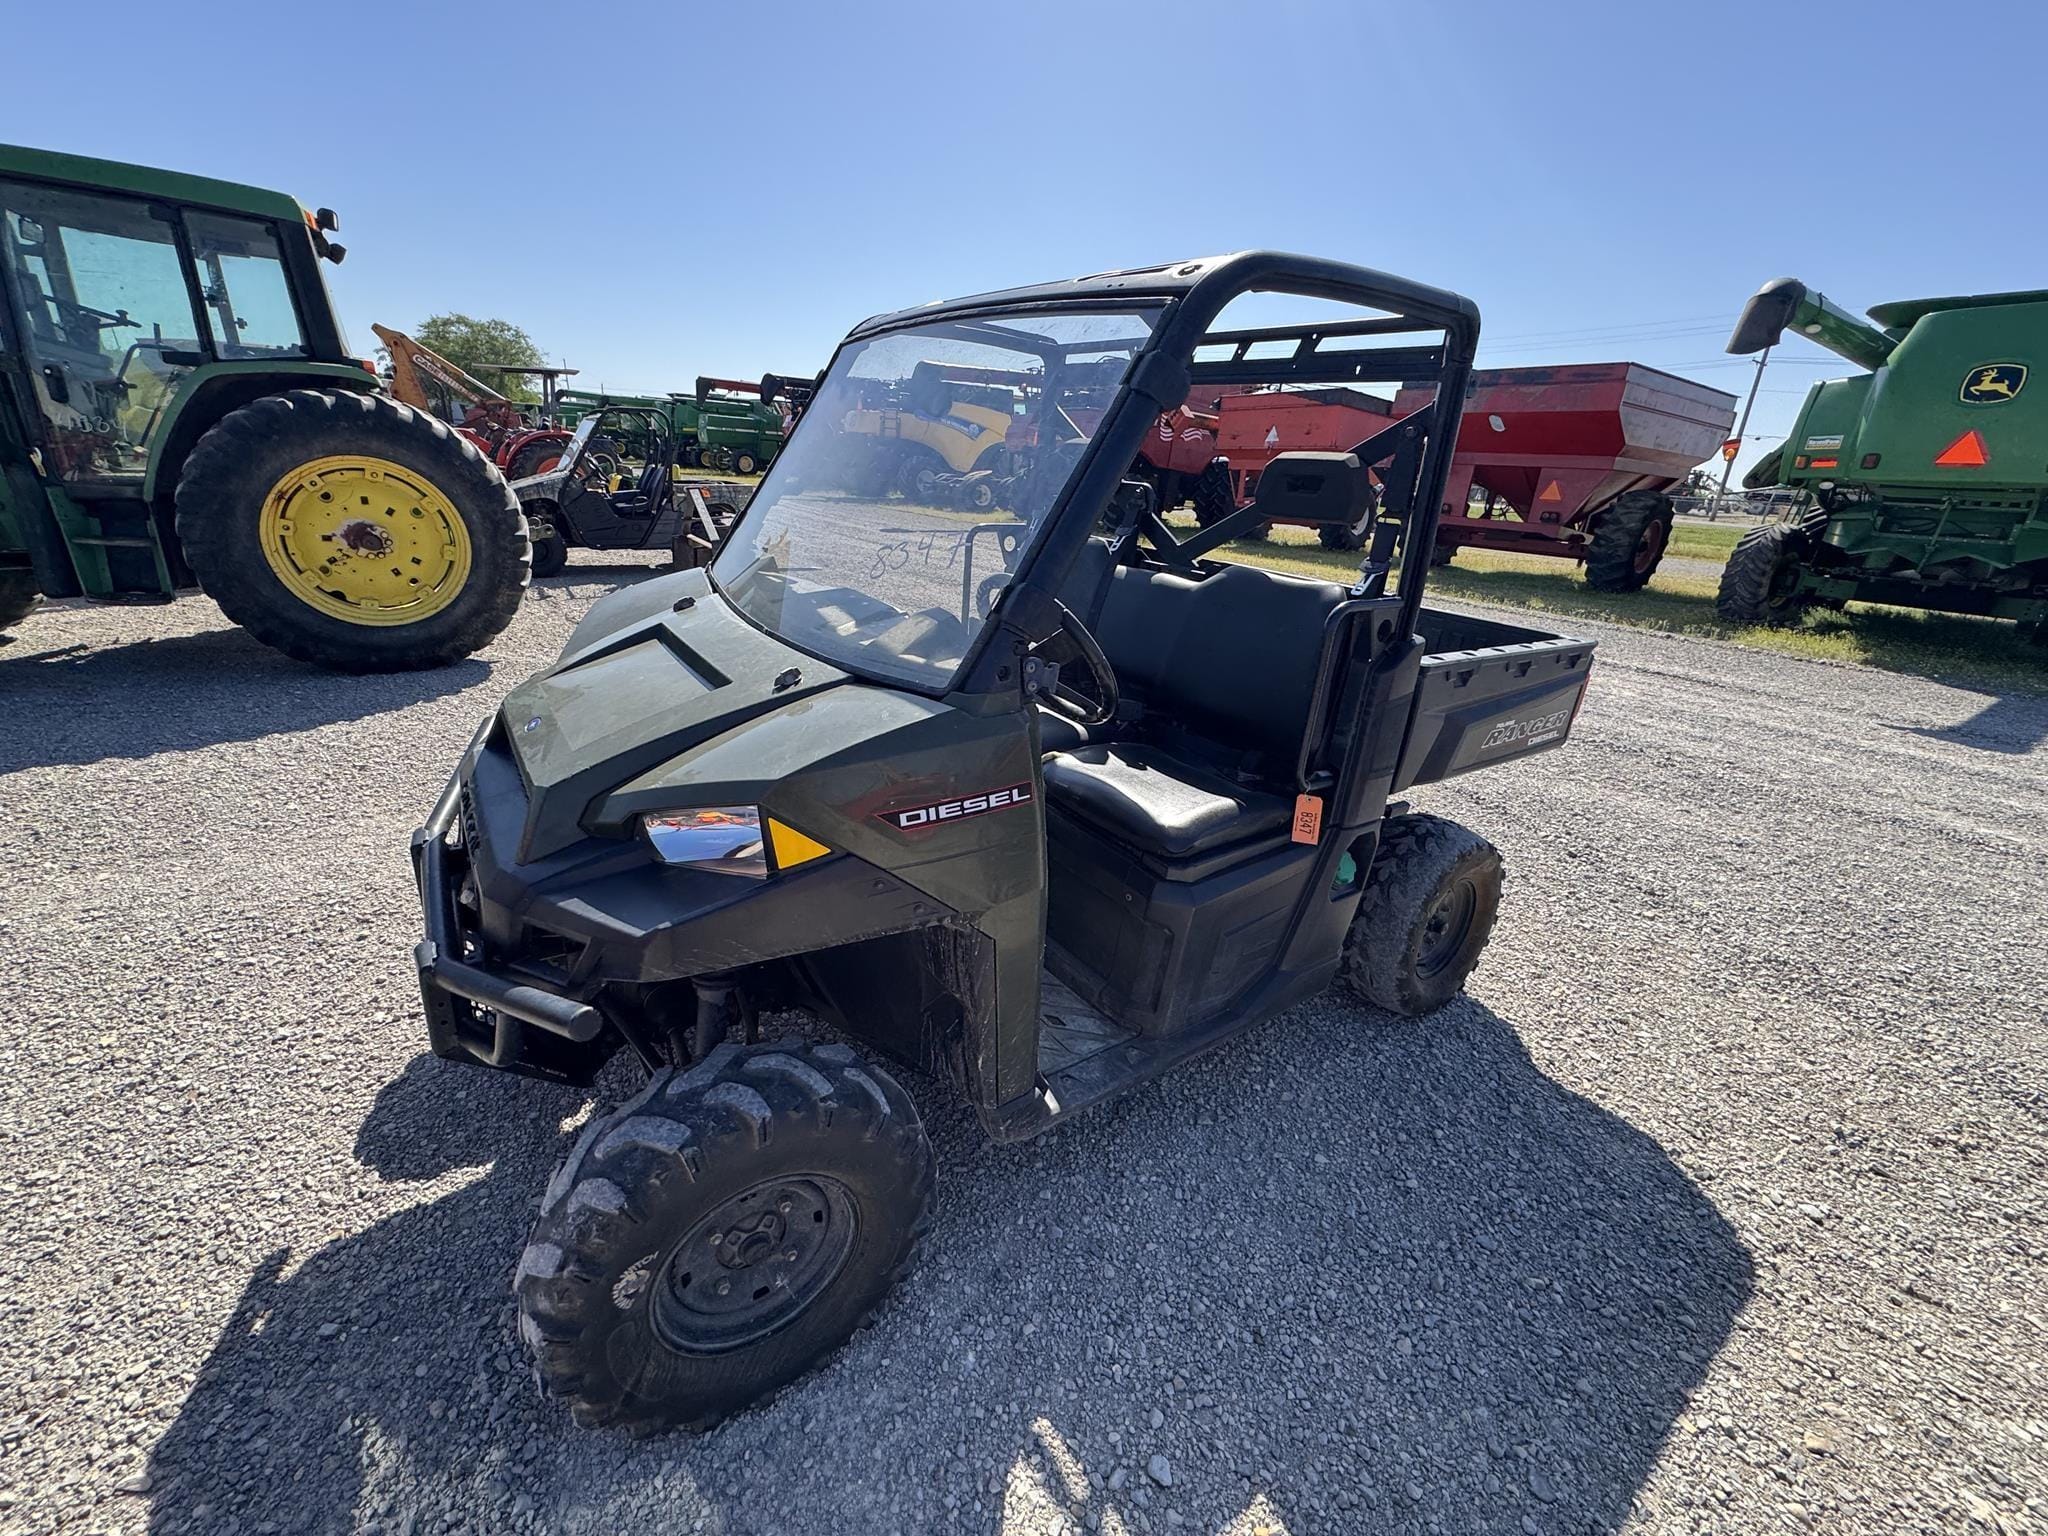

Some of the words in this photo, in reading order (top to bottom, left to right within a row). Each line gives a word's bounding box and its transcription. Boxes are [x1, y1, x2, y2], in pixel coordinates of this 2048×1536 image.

[870, 530, 965, 579] 8347
[1481, 710, 1568, 748] RANGER
[1528, 731, 1559, 745] DIESEL
[899, 789, 1030, 826] DIESEL
[1299, 812, 1313, 834] 8347
